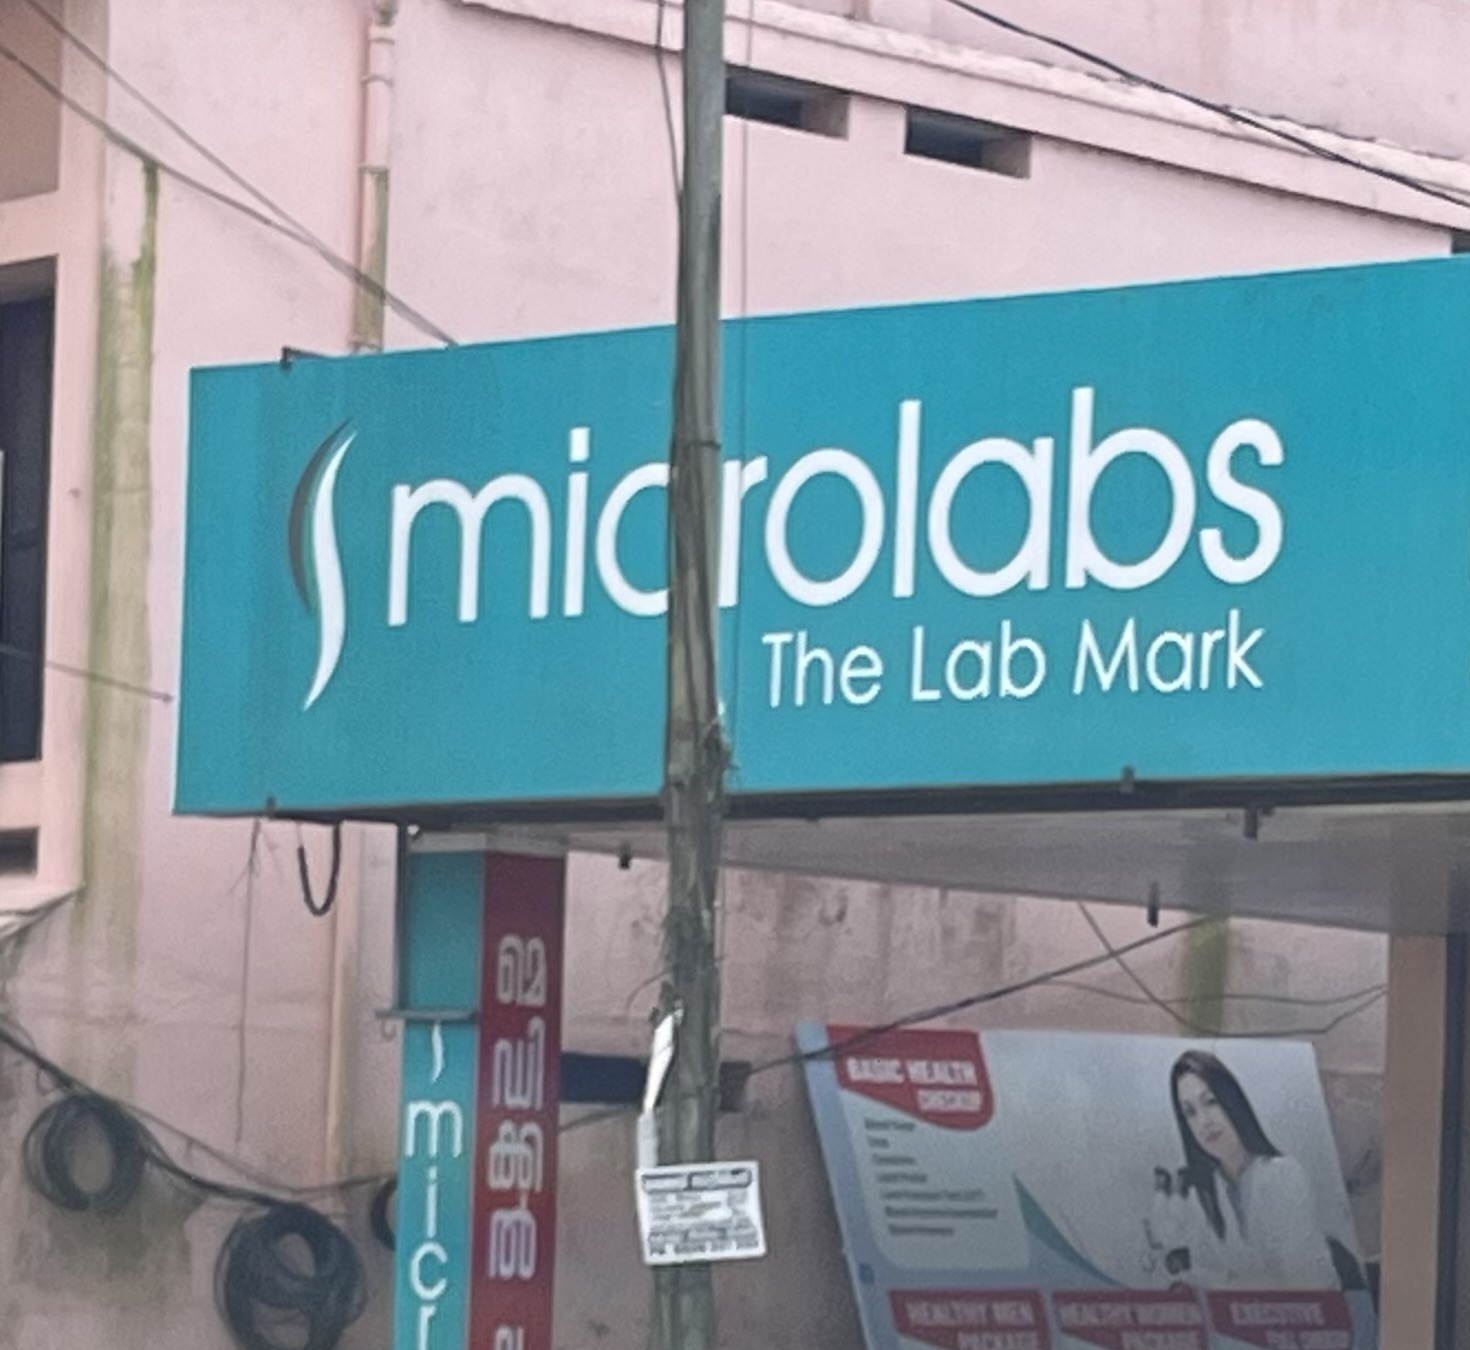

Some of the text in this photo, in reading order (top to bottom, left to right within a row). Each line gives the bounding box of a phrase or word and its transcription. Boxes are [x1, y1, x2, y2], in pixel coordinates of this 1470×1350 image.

[388, 387, 1284, 627] microlabs
[761, 608, 1264, 708] The Lab Mark
